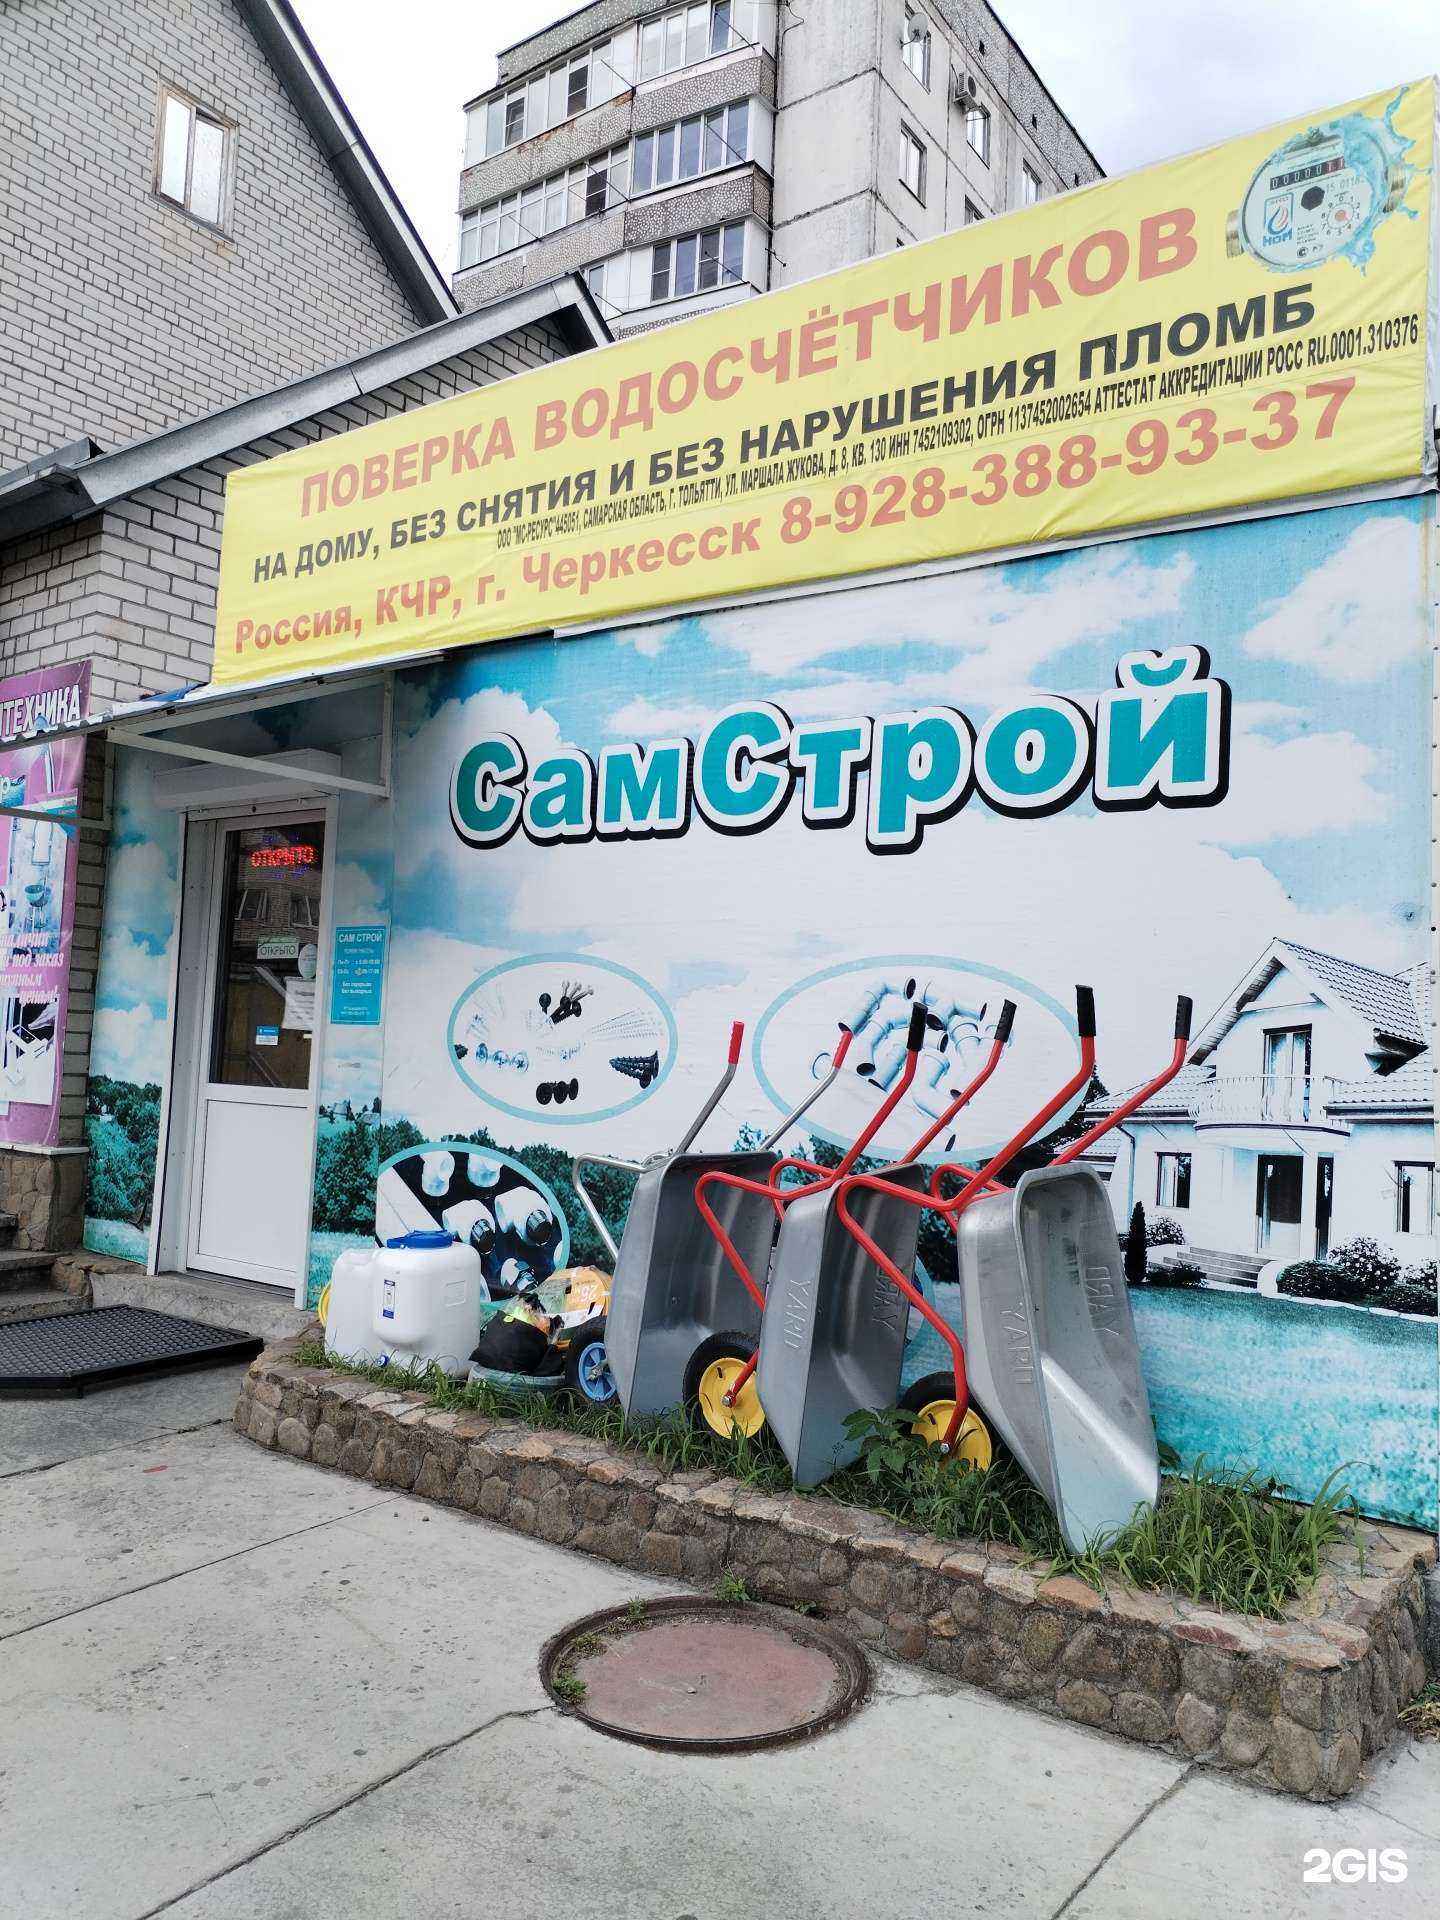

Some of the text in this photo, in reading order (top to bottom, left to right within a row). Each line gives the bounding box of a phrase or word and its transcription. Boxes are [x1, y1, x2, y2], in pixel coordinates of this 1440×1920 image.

[254, 283, 1315, 583] НА ДОМУ, БЕЗ СНЯТИЯ И БЕЗ НАРУШЕНИЯ ПЛОМБ
[301, 206, 1198, 517] ПОВЕРКА ВОДОСЧЁТЧИКОВ
[497, 529, 511, 549] ООО
[583, 498, 627, 527] САМАРСКАЯ
[629, 490, 667, 517] ОБЛАСТЬ,
[679, 475, 723, 506] ТОЛЬЯТТИ,
[725, 472, 738, 496] УЛ.
[740, 461, 784, 493] МАРШАЛА
[786, 450, 827, 480] ЖУКОВА,
[829, 450, 839, 478] Д.
[841, 446, 849, 473] 8,
[852, 441, 867, 467] КВ.
[870, 437, 886, 463] 130
[889, 431, 910, 459] ИНН
[913, 417, 974, 454] 7452109302,
[977, 409, 1005, 440] ОГРН
[1009, 388, 1091, 432] 1137452002654
[1094, 374, 1156, 414] АТТЕСТАТ
[1159, 349, 1262, 400] АККРЕДИТАЦИИ
[1267, 340, 1303, 376] РОСС
[1307, 314, 1419, 367] RU.0001.310376
[235, 376, 1356, 653] Россия, КЧР, г. Черкесск 8-928-388-93-37
[0, 683, 81, 737] ТЕХНИКА
[450, 645, 1231, 856] СамСтрой
[250, 845, 315, 867] ОТКРЫТО
[260, 944, 296, 956] ОТКРЫТО
[339, 932, 354, 943] САМ
